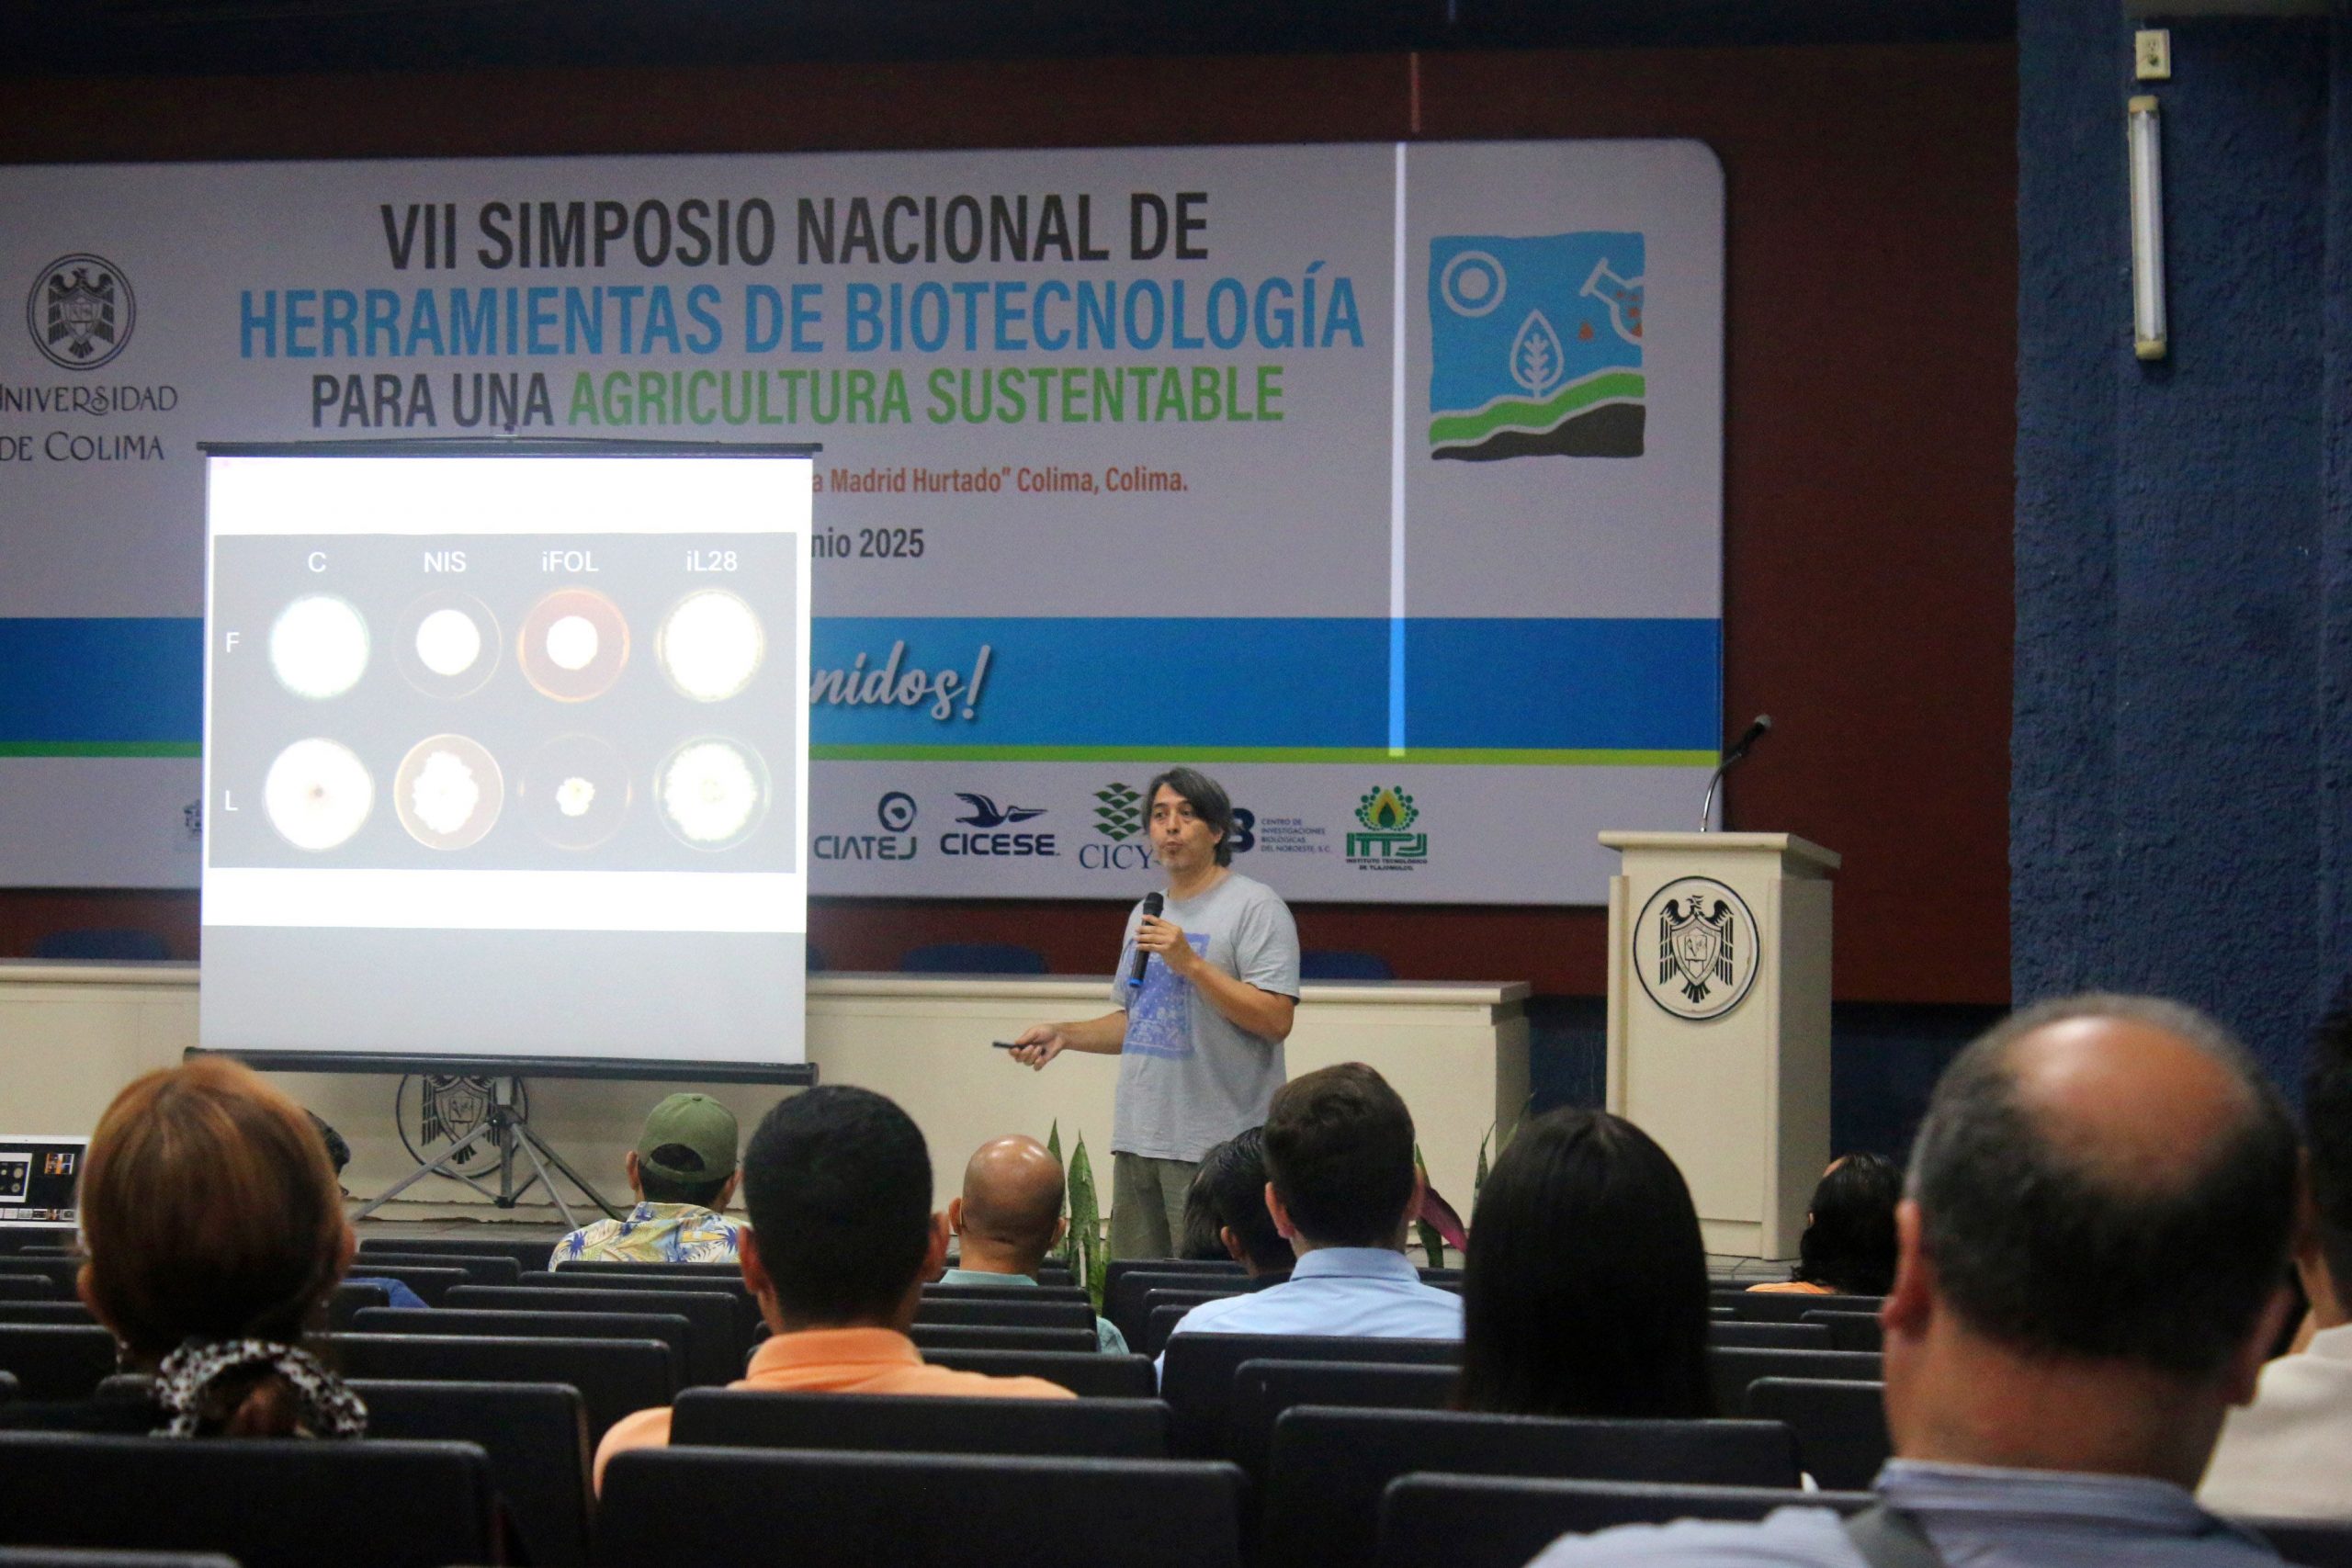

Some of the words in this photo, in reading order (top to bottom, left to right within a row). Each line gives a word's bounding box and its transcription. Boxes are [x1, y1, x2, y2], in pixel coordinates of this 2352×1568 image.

[380, 203, 457, 270] VII
[477, 197, 775, 269] SIMPOSIO
[797, 192, 1110, 265] NACIONAL
[1129, 191, 1209, 262] DE
[240, 284, 723, 359] HERRAMIENTAS
[745, 282, 824, 355] DE
[845, 259, 1364, 354] BIOTECNOLOGÍA
[0, 383, 178, 416] NIVERSIDAD
[312, 372, 437, 428] PARA
[452, 371, 554, 427] UNA
[568, 367, 912, 426] AGRICULTURA
[926, 365, 1284, 424] SUSTENTABLE
[45, 430, 164, 461] COLIMA
[831, 467, 906, 493] Madrid
[912, 467, 1011, 493] Hurtado"
[1017, 467, 1101, 496] Colima,
[1105, 466, 1189, 492] Colima.
[859, 527, 925, 558] 2025
[307, 552, 327, 573] C
[423, 552, 468, 573] NIS
[541, 551, 600, 573] iFOL
[685, 551, 739, 572] iL28
[225, 632, 240, 652] F
[224, 790, 239, 811] L
[1261, 818, 1291, 826] CENTRO
[813, 835, 918, 861] CIATEJ
[940, 832, 1056, 856] CICESE
[1079, 843, 1154, 870] CICY
